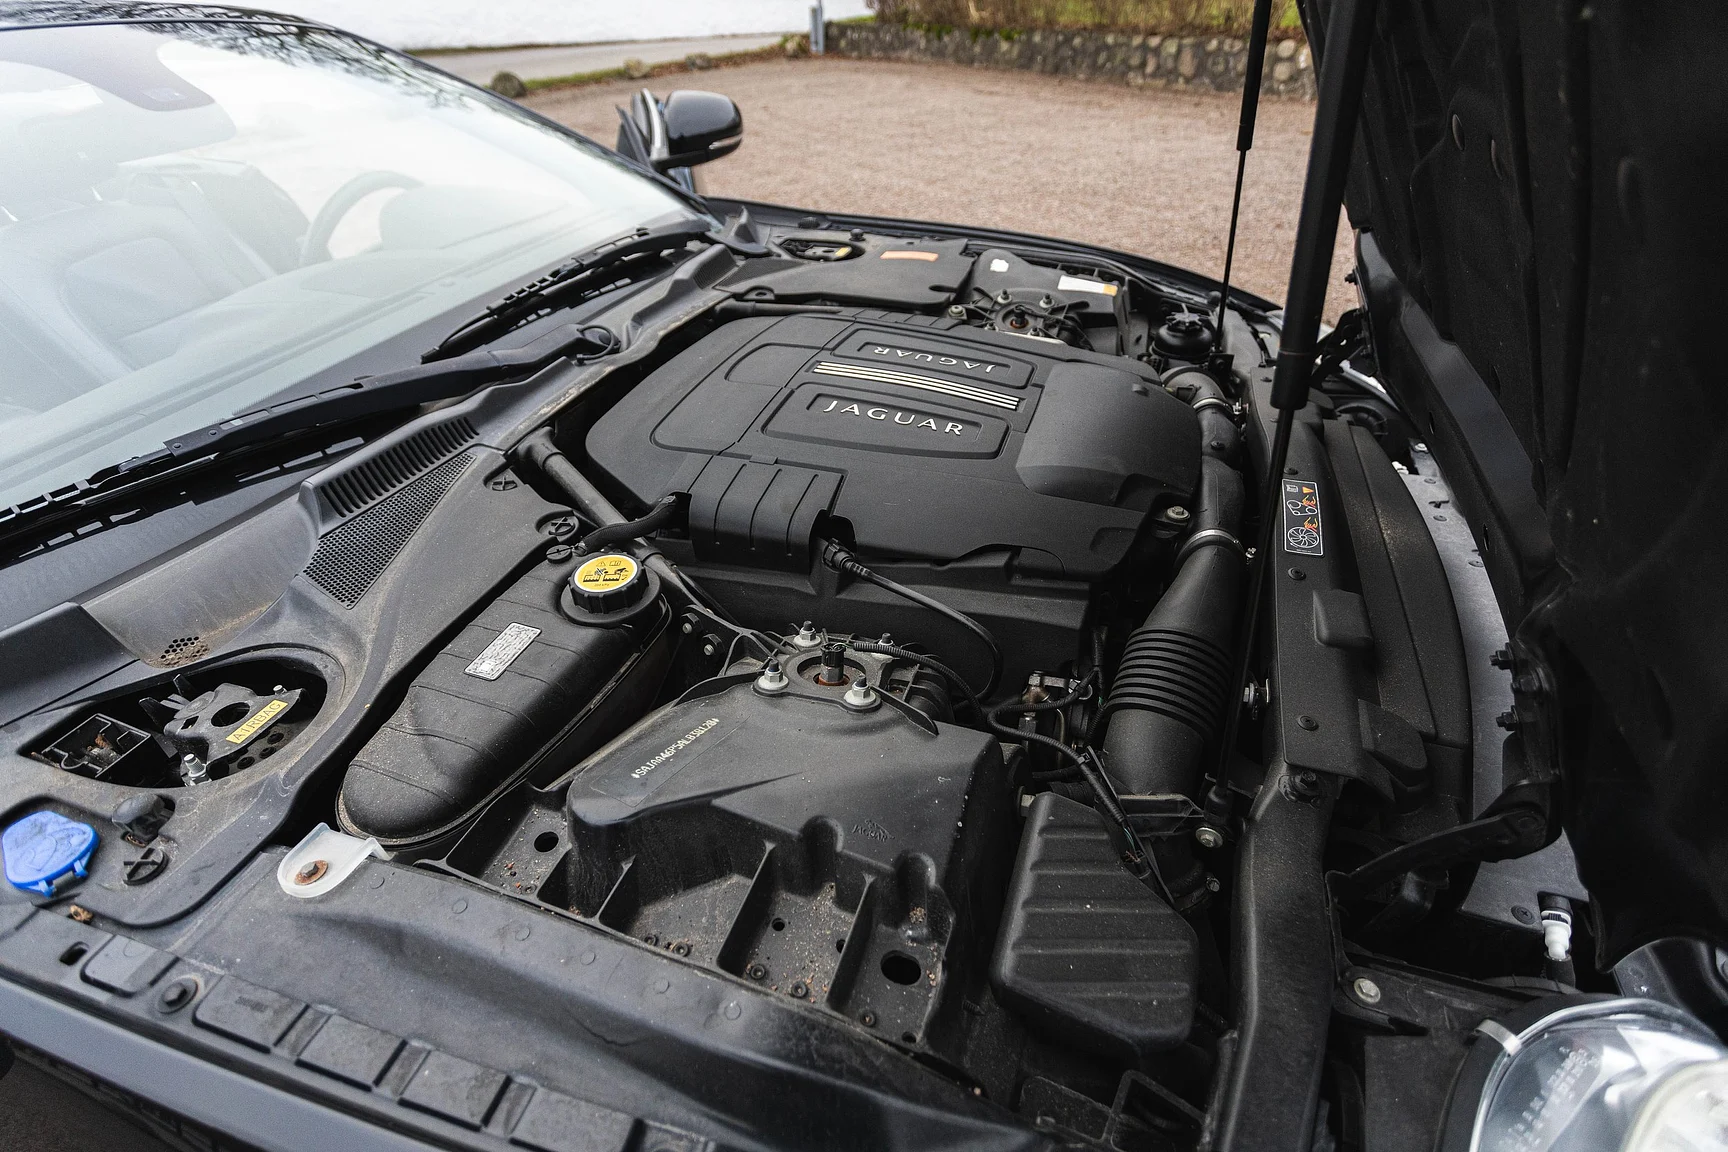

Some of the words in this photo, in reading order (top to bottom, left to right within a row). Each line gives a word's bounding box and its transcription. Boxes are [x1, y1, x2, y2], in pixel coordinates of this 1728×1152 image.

[874, 346, 996, 373] JAGUAR
[823, 400, 964, 435] JAGUAR
[233, 703, 281, 741] AIRBAG
